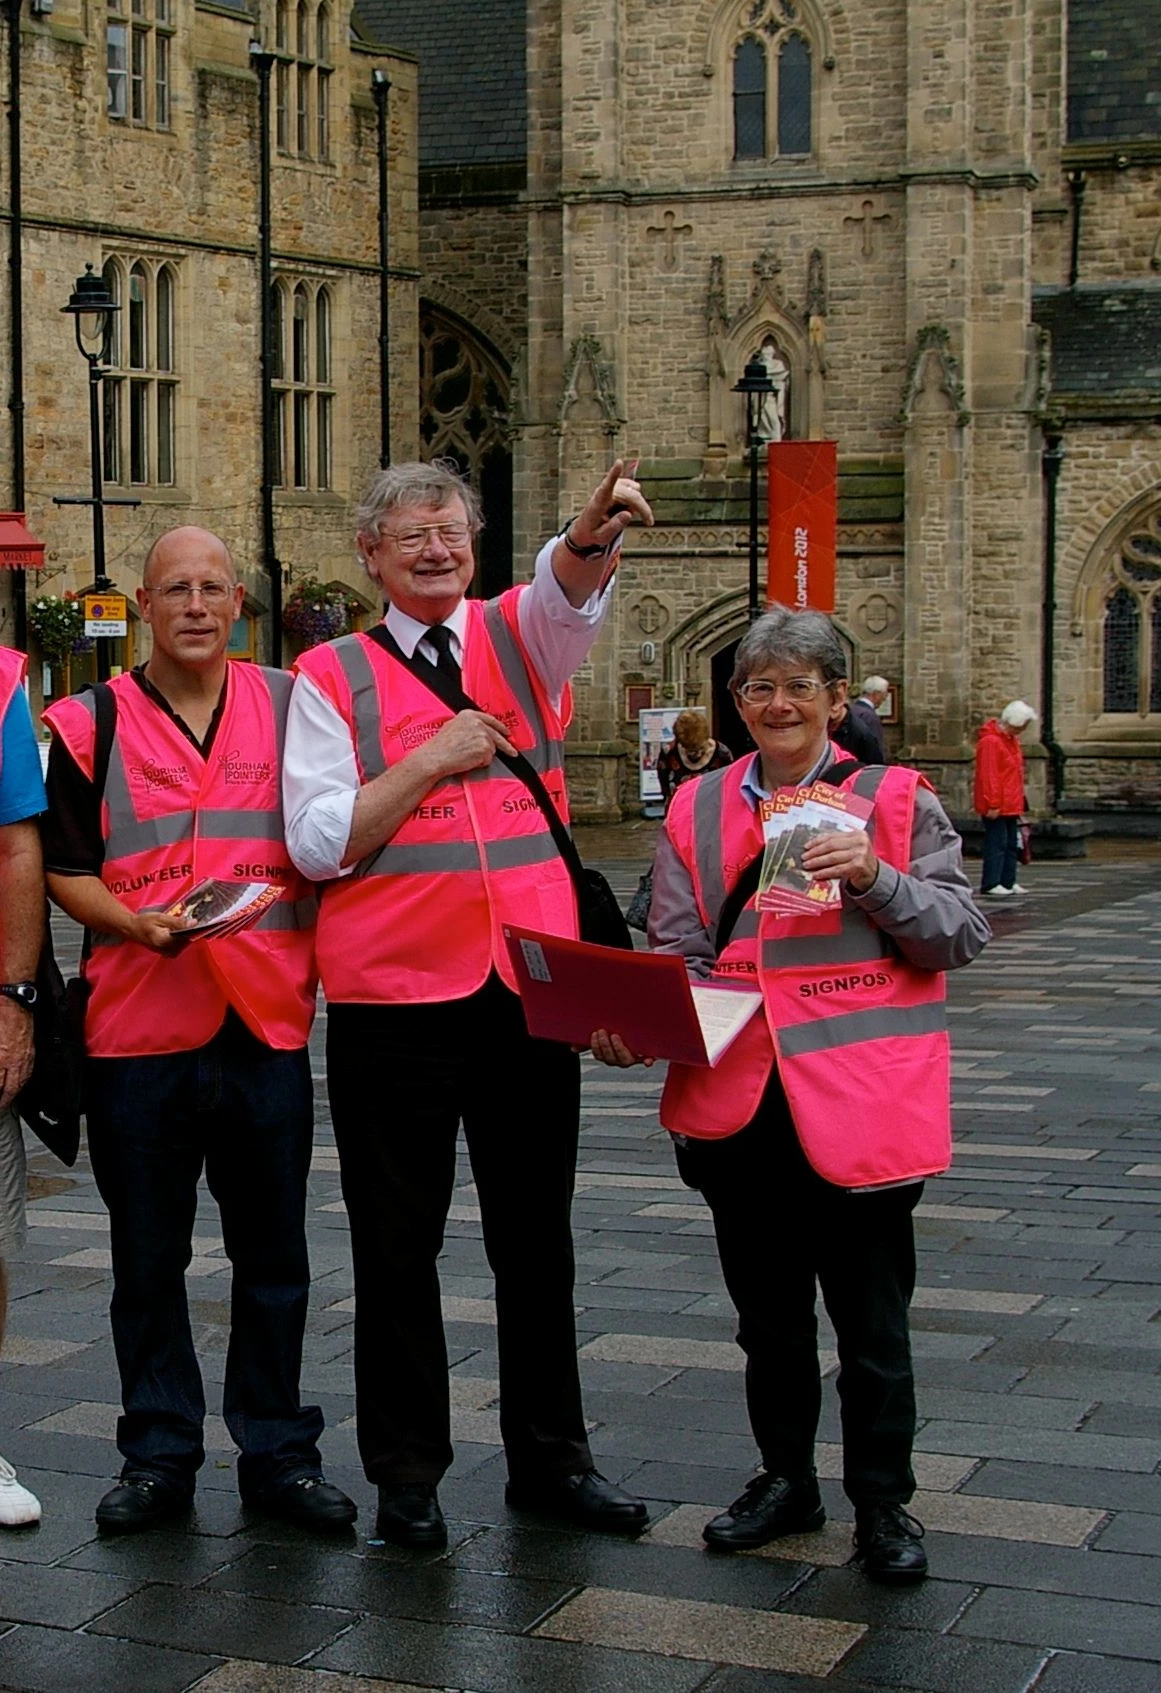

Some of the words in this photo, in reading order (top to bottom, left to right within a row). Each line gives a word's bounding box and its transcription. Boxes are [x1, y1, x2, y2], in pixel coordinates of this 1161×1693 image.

[794, 527, 808, 557] 2012
[794, 560, 808, 608] London
[227, 762, 270, 770] DURHAM
[811, 791, 846, 810] Durham
[815, 783, 835, 799] City
